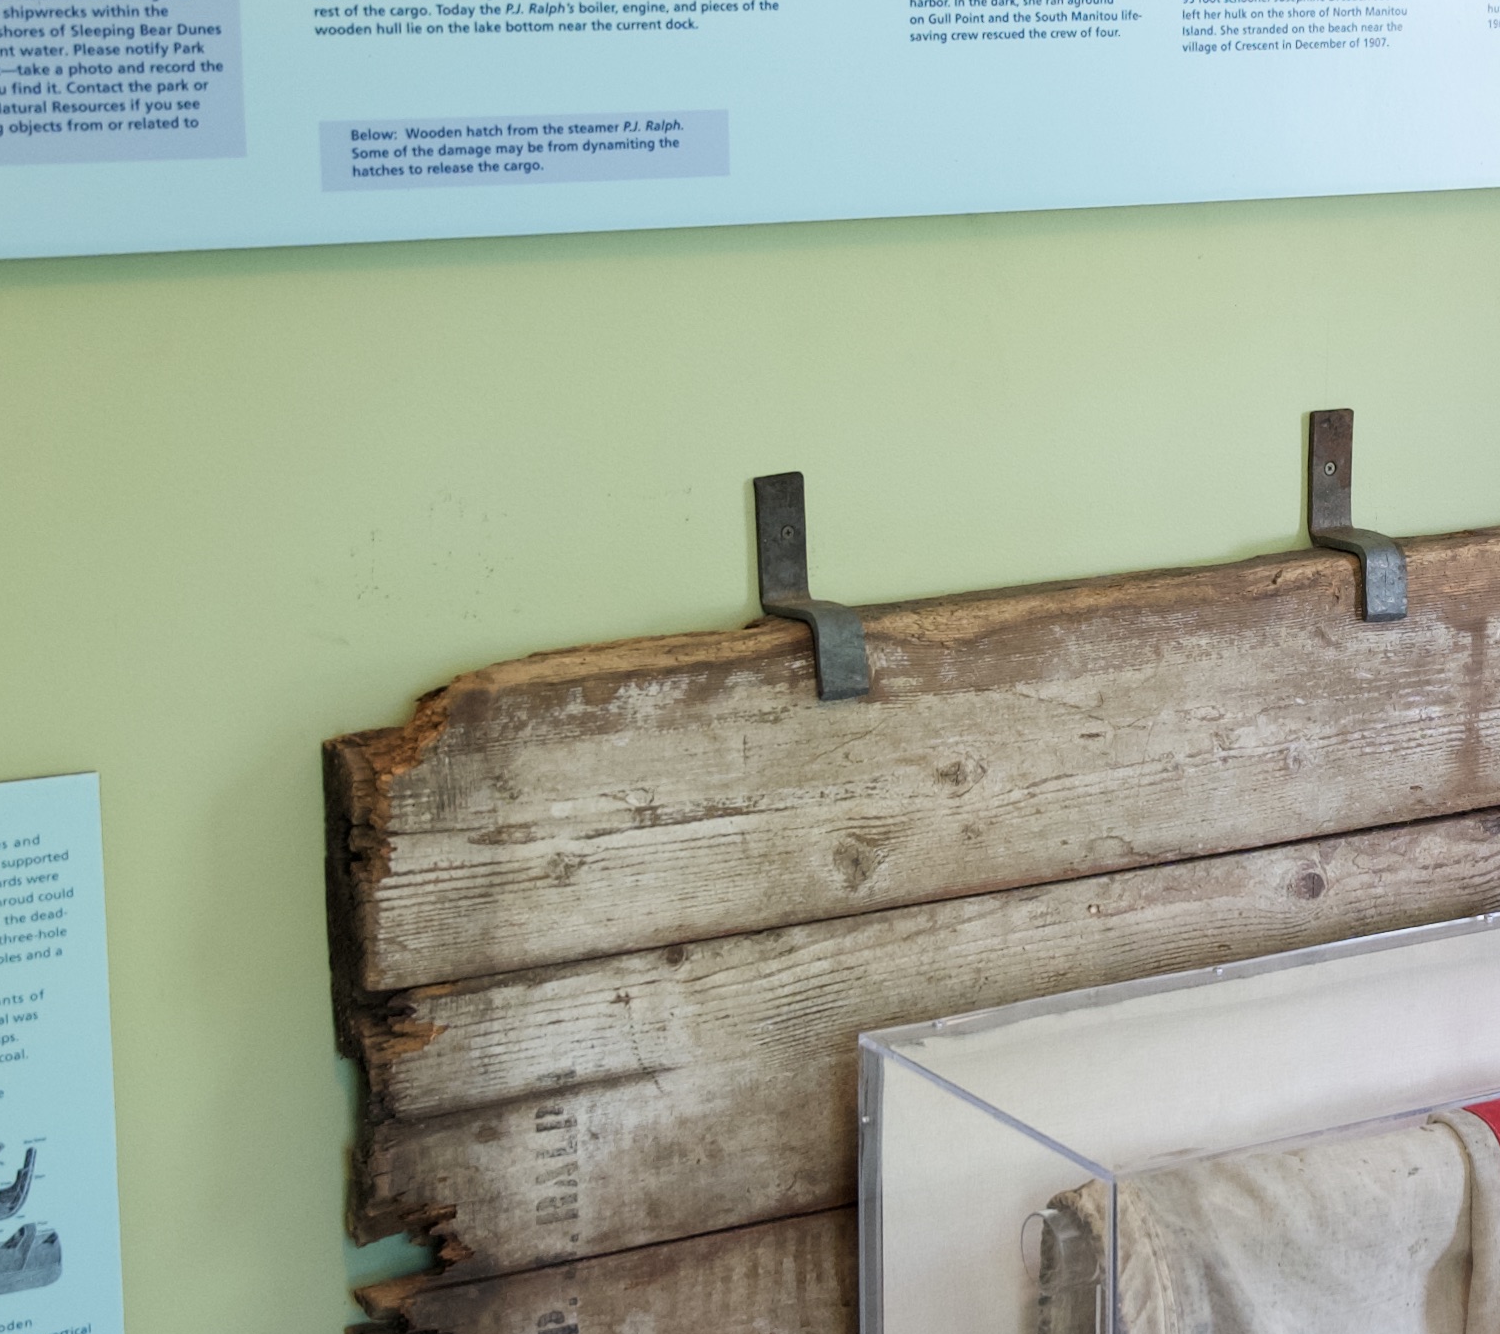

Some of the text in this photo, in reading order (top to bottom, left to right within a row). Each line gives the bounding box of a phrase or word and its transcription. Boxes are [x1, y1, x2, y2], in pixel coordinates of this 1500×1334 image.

[350, 119, 684, 142] Below: Wooden hatch from the steamer P.J. Ralph.
